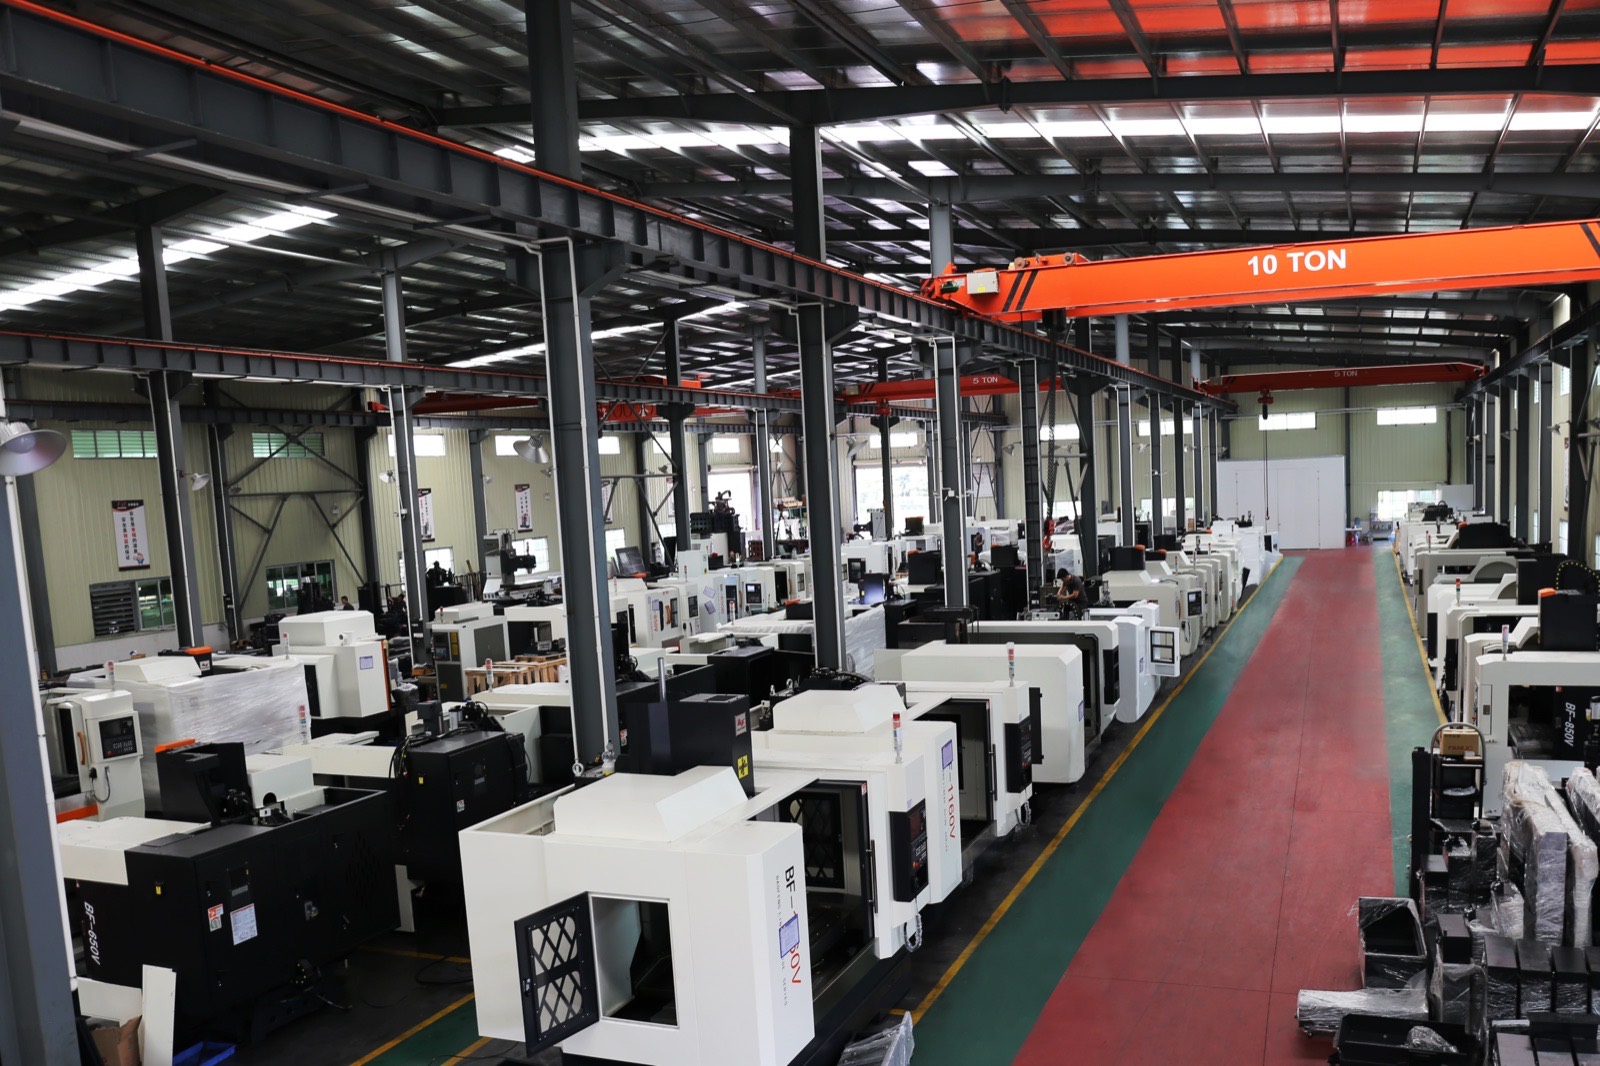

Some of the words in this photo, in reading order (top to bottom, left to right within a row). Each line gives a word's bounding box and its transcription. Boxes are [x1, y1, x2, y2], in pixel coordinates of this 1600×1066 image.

[1248, 254, 1278, 276] 10
[1286, 249, 1347, 273] TON
[982, 376, 998, 384] TON
[1564, 702, 1576, 747] BF-850V
[84, 901, 101, 966] BF-650V
